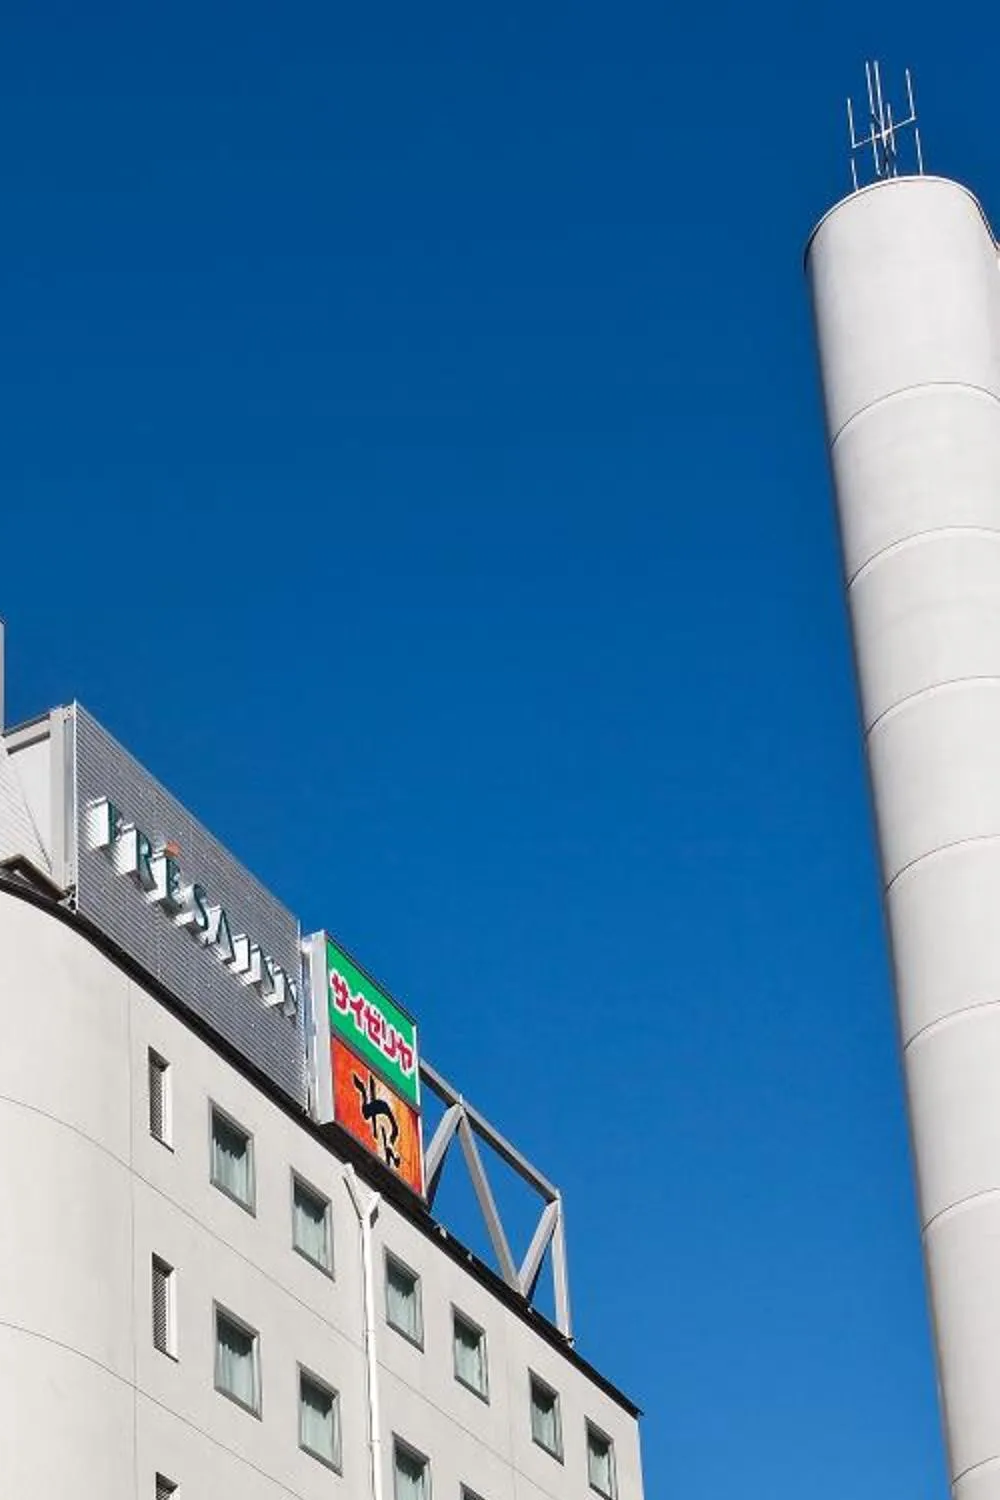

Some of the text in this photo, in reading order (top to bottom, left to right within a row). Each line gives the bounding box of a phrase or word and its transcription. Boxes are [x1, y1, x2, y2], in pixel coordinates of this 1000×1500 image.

[330, 969, 416, 1080] サイゼリヤ
